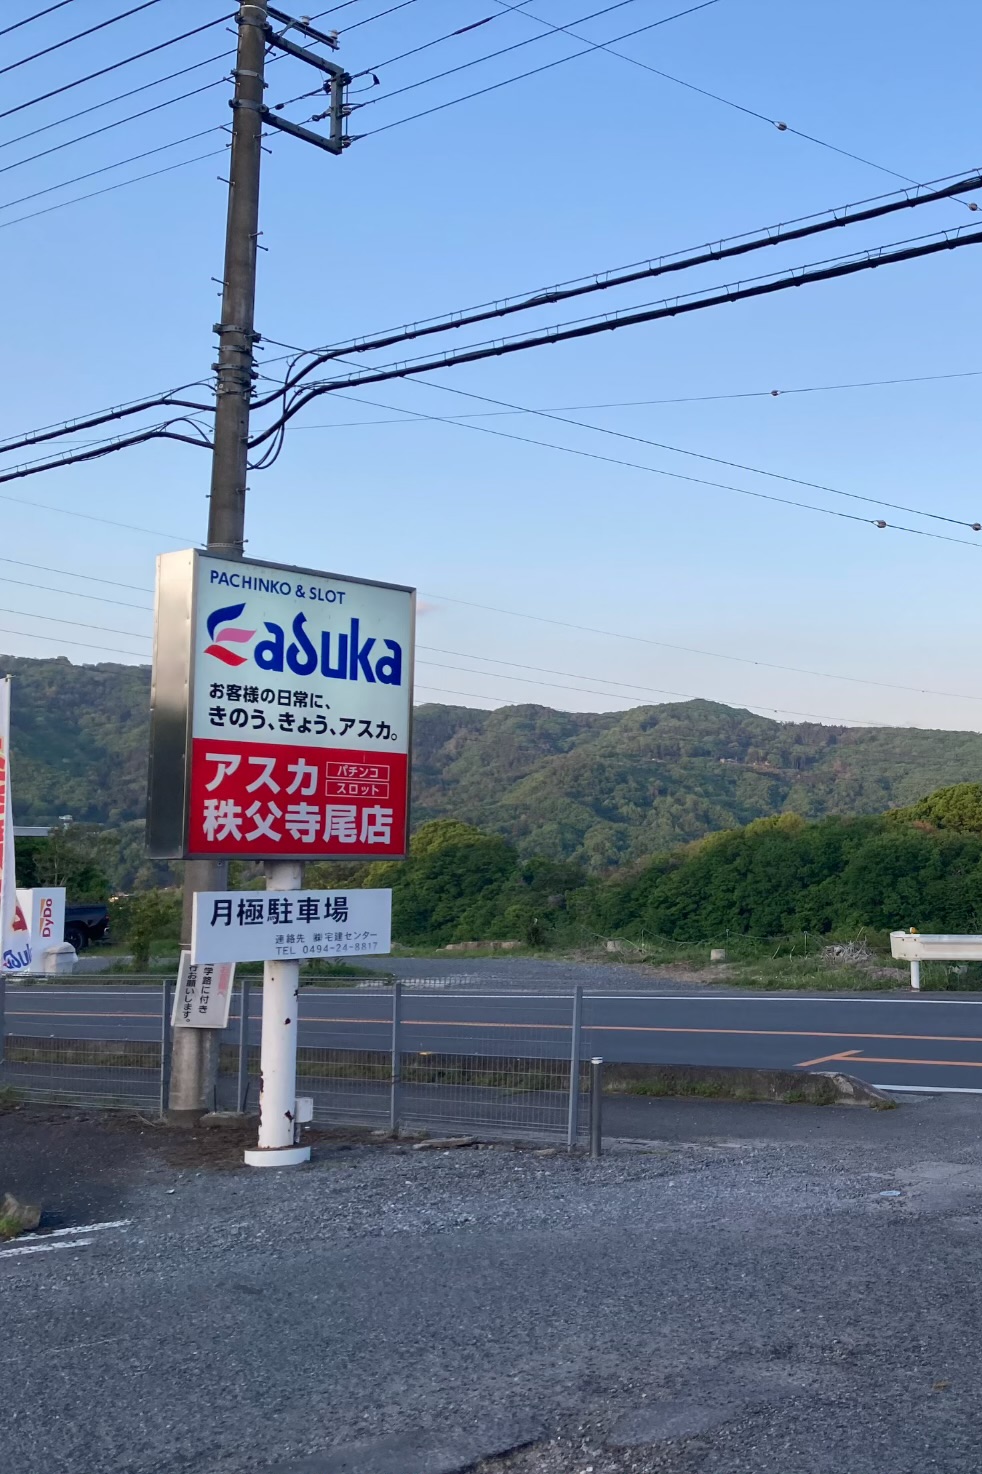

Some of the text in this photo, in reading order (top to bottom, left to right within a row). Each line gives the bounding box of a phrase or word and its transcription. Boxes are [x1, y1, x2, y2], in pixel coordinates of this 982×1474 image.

[209, 569, 346, 605] PACHINKO & SLOT
[208, 682, 332, 710] お客様の日常に、
[207, 705, 398, 742] きのう、きょう、アスカ。
[204, 752, 319, 796] アスカ
[336, 764, 380, 779] パチンコ
[336, 782, 380, 797] スロット
[202, 798, 394, 845] 秩父寺尾店
[42, 898, 54, 938] DyDo
[209, 896, 350, 928] 月極駐車場
[275, 946, 297, 956] TEL
[198, 963, 214, 1014] 学路に付き
